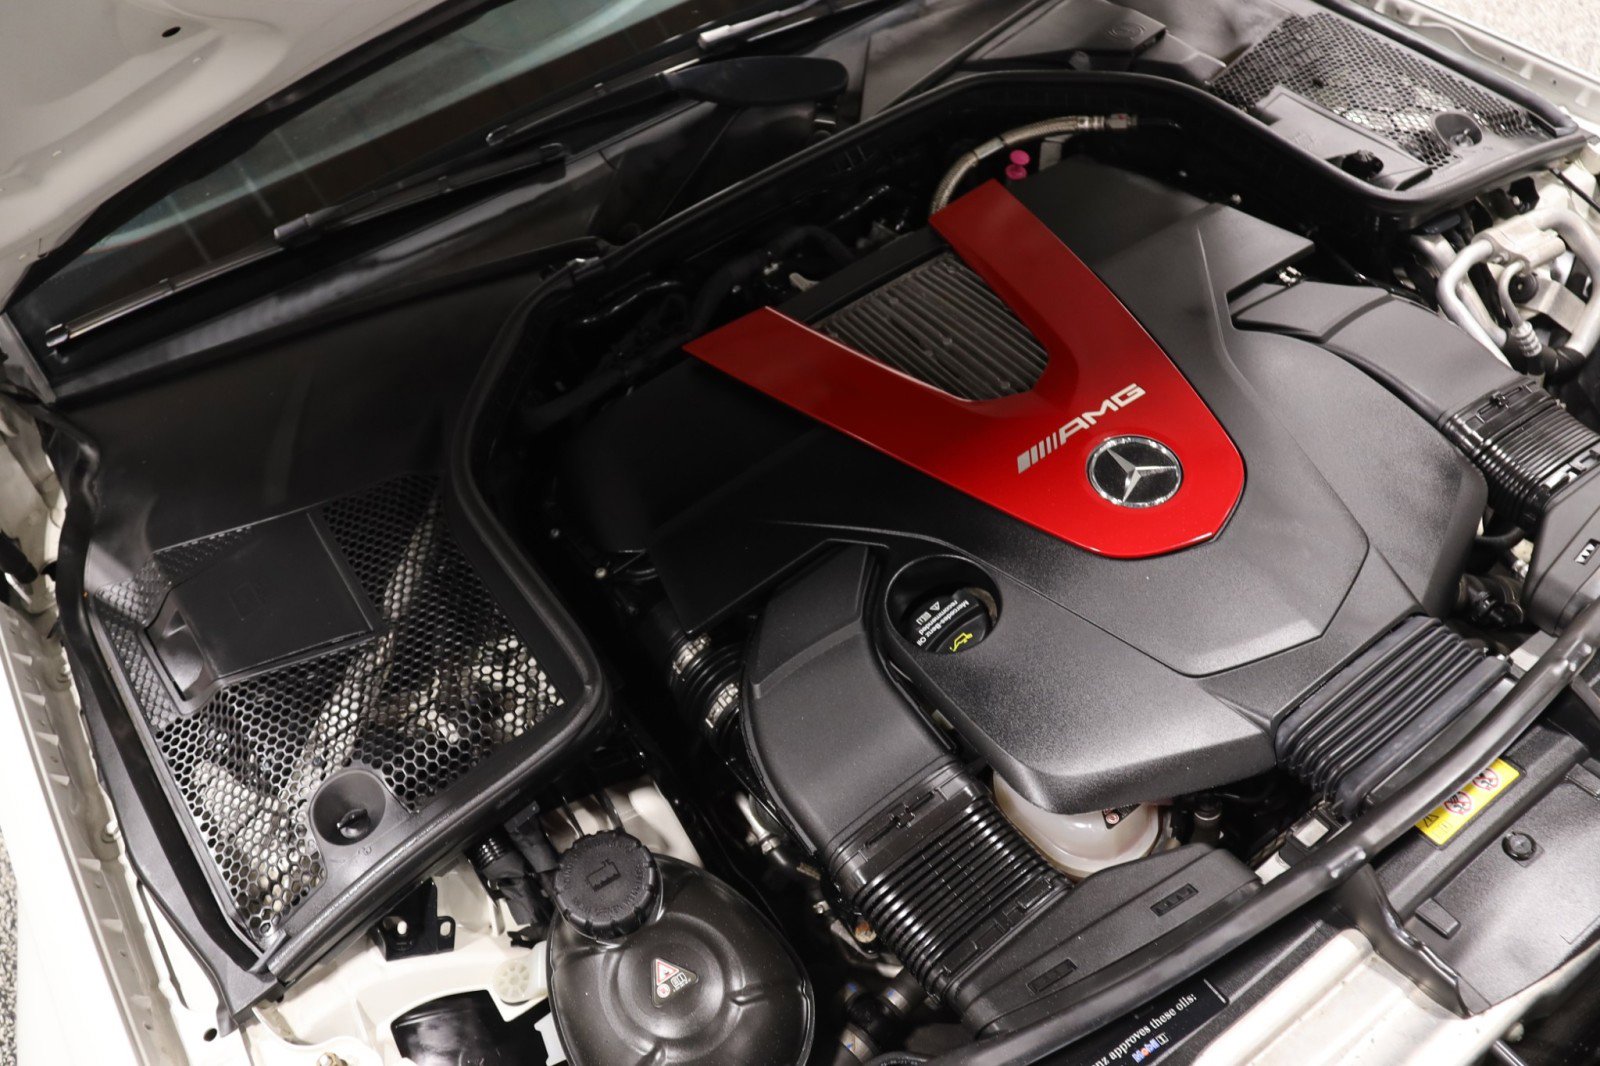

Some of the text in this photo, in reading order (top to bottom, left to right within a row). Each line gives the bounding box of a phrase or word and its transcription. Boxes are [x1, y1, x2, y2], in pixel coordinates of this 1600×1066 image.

[1059, 383, 1146, 446] AMG
[916, 600, 969, 647] Mercedes-Benz Oil
[918, 600, 958, 636] recommended
[1108, 1025, 1151, 1059] approves
[1149, 1008, 1177, 1029] these
[1131, 1038, 1159, 1063] Mobil
